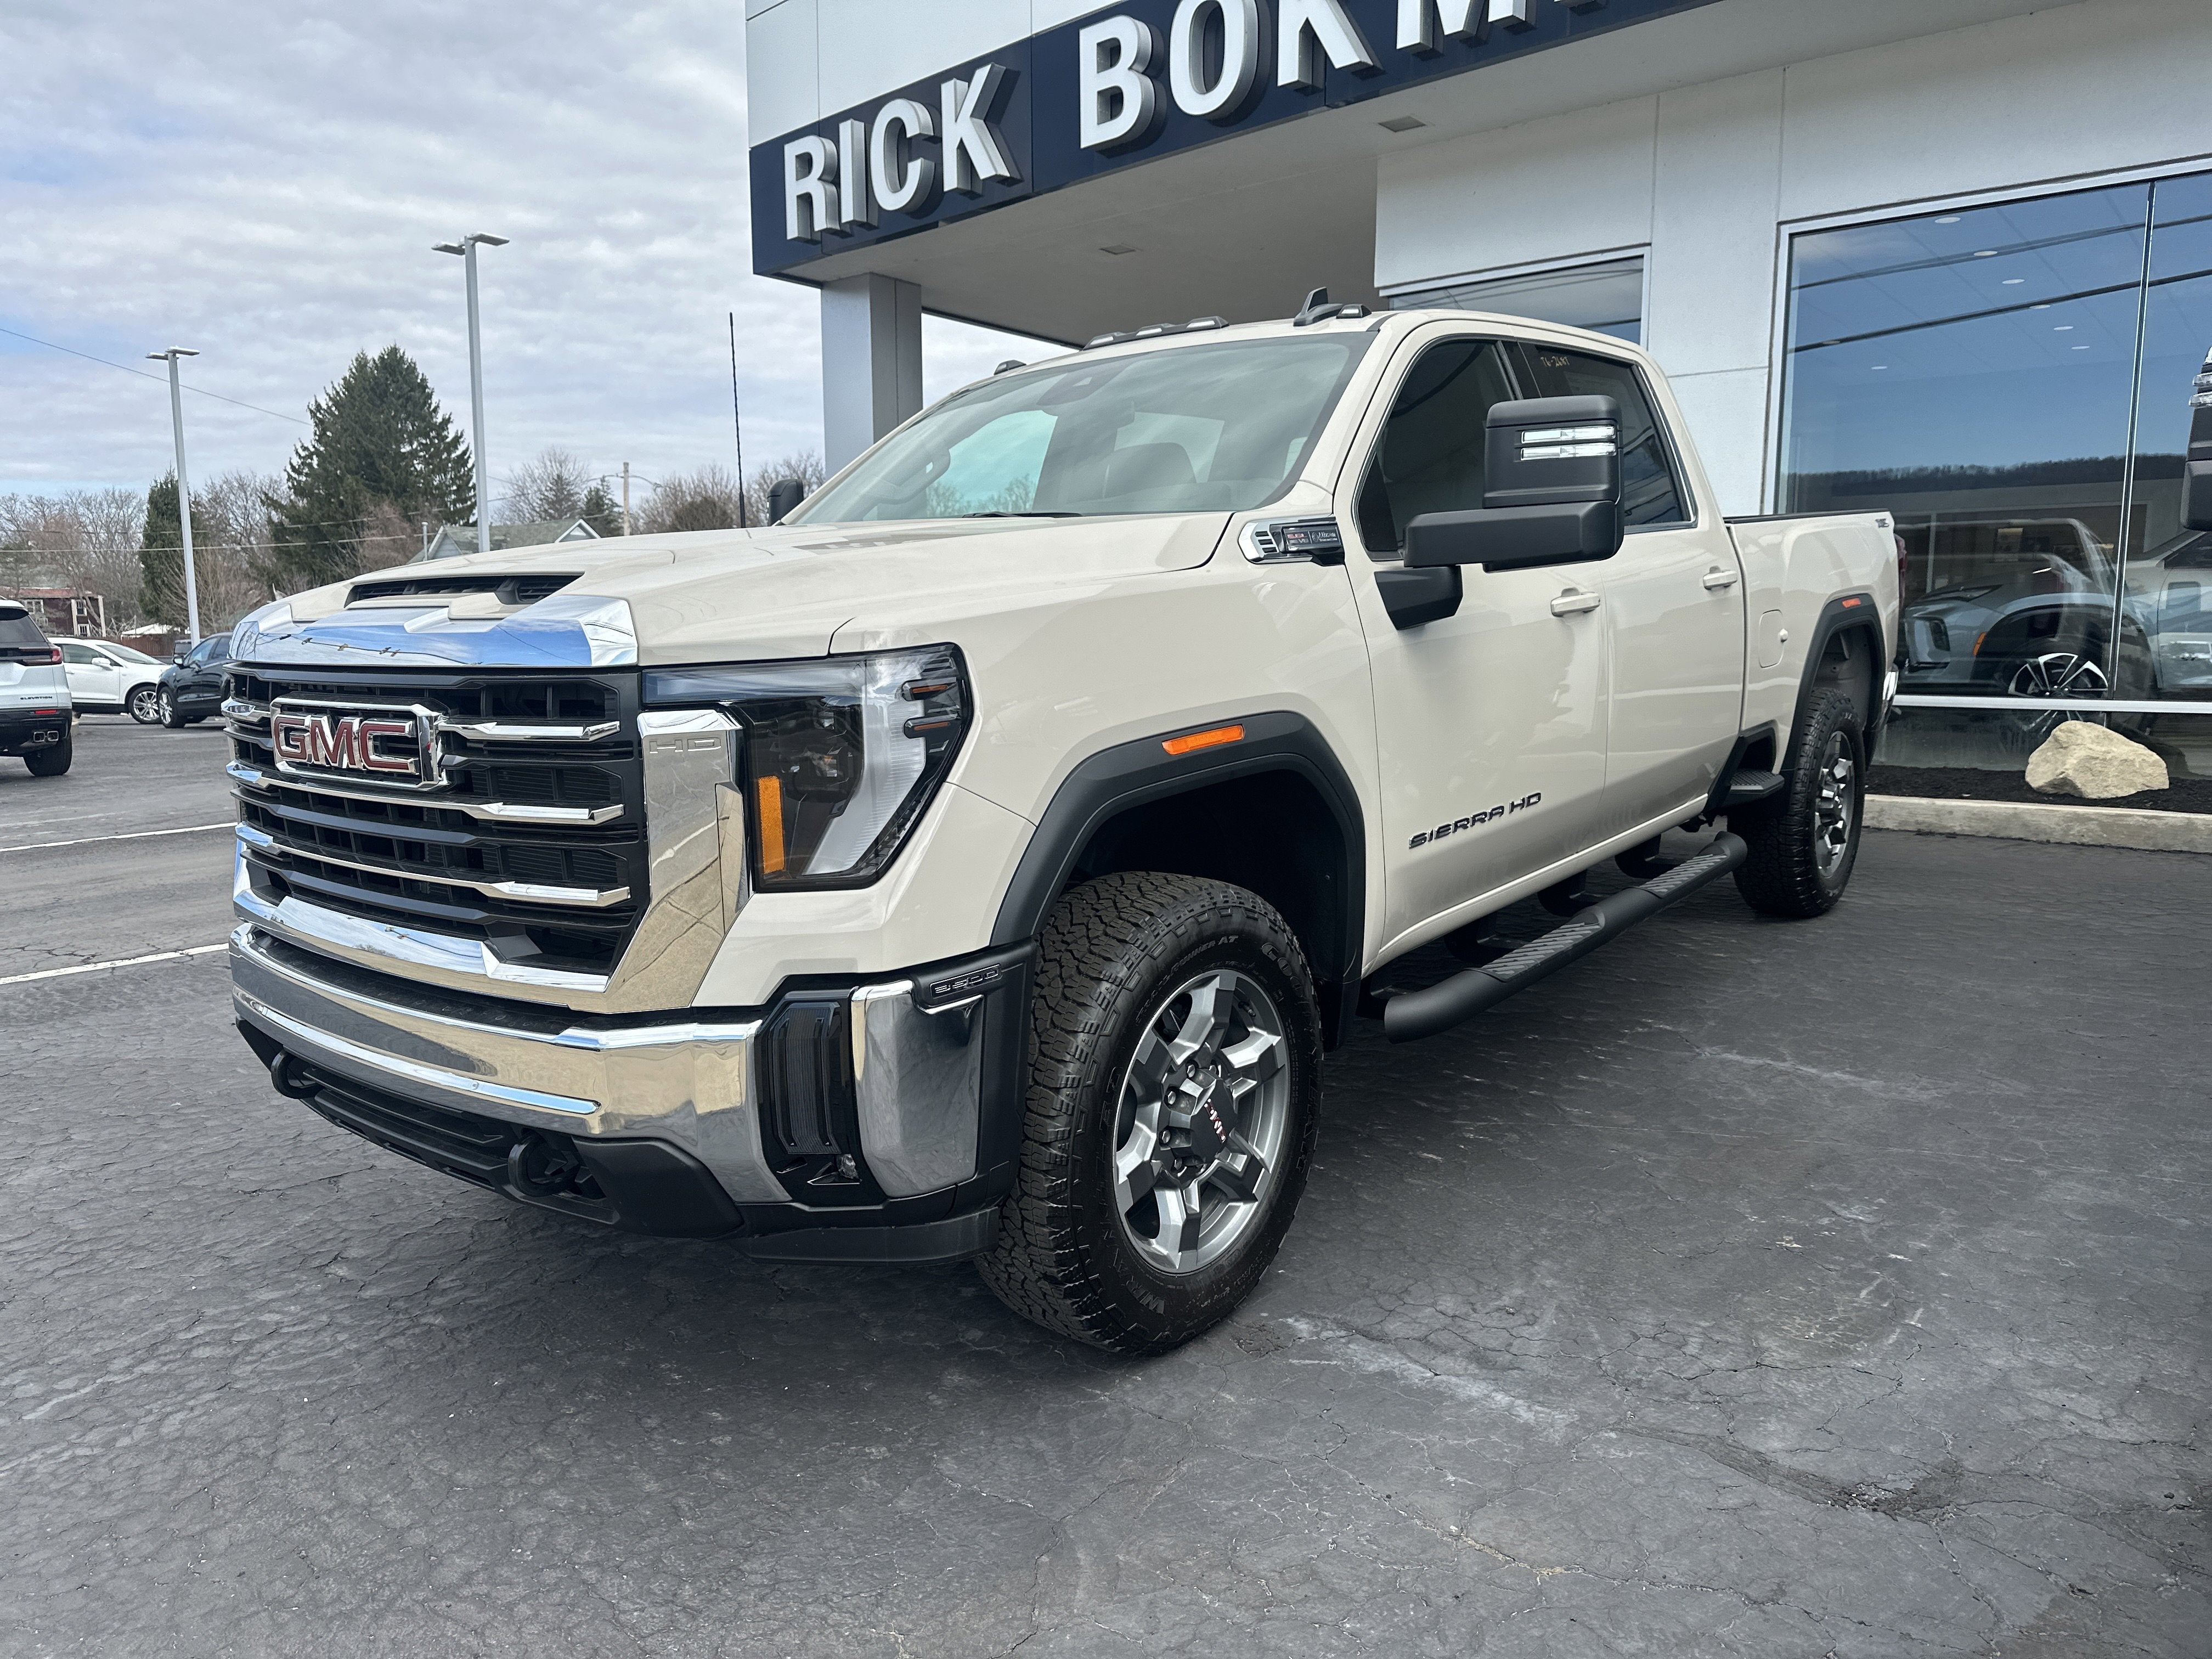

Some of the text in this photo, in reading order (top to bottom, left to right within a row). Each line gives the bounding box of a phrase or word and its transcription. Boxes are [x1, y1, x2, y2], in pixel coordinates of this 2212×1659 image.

[785, 62, 1022, 240] RICK
[272, 713, 421, 776] GMC
[649, 737, 721, 754] HD
[1408, 791, 1542, 849] SIERRA HD
